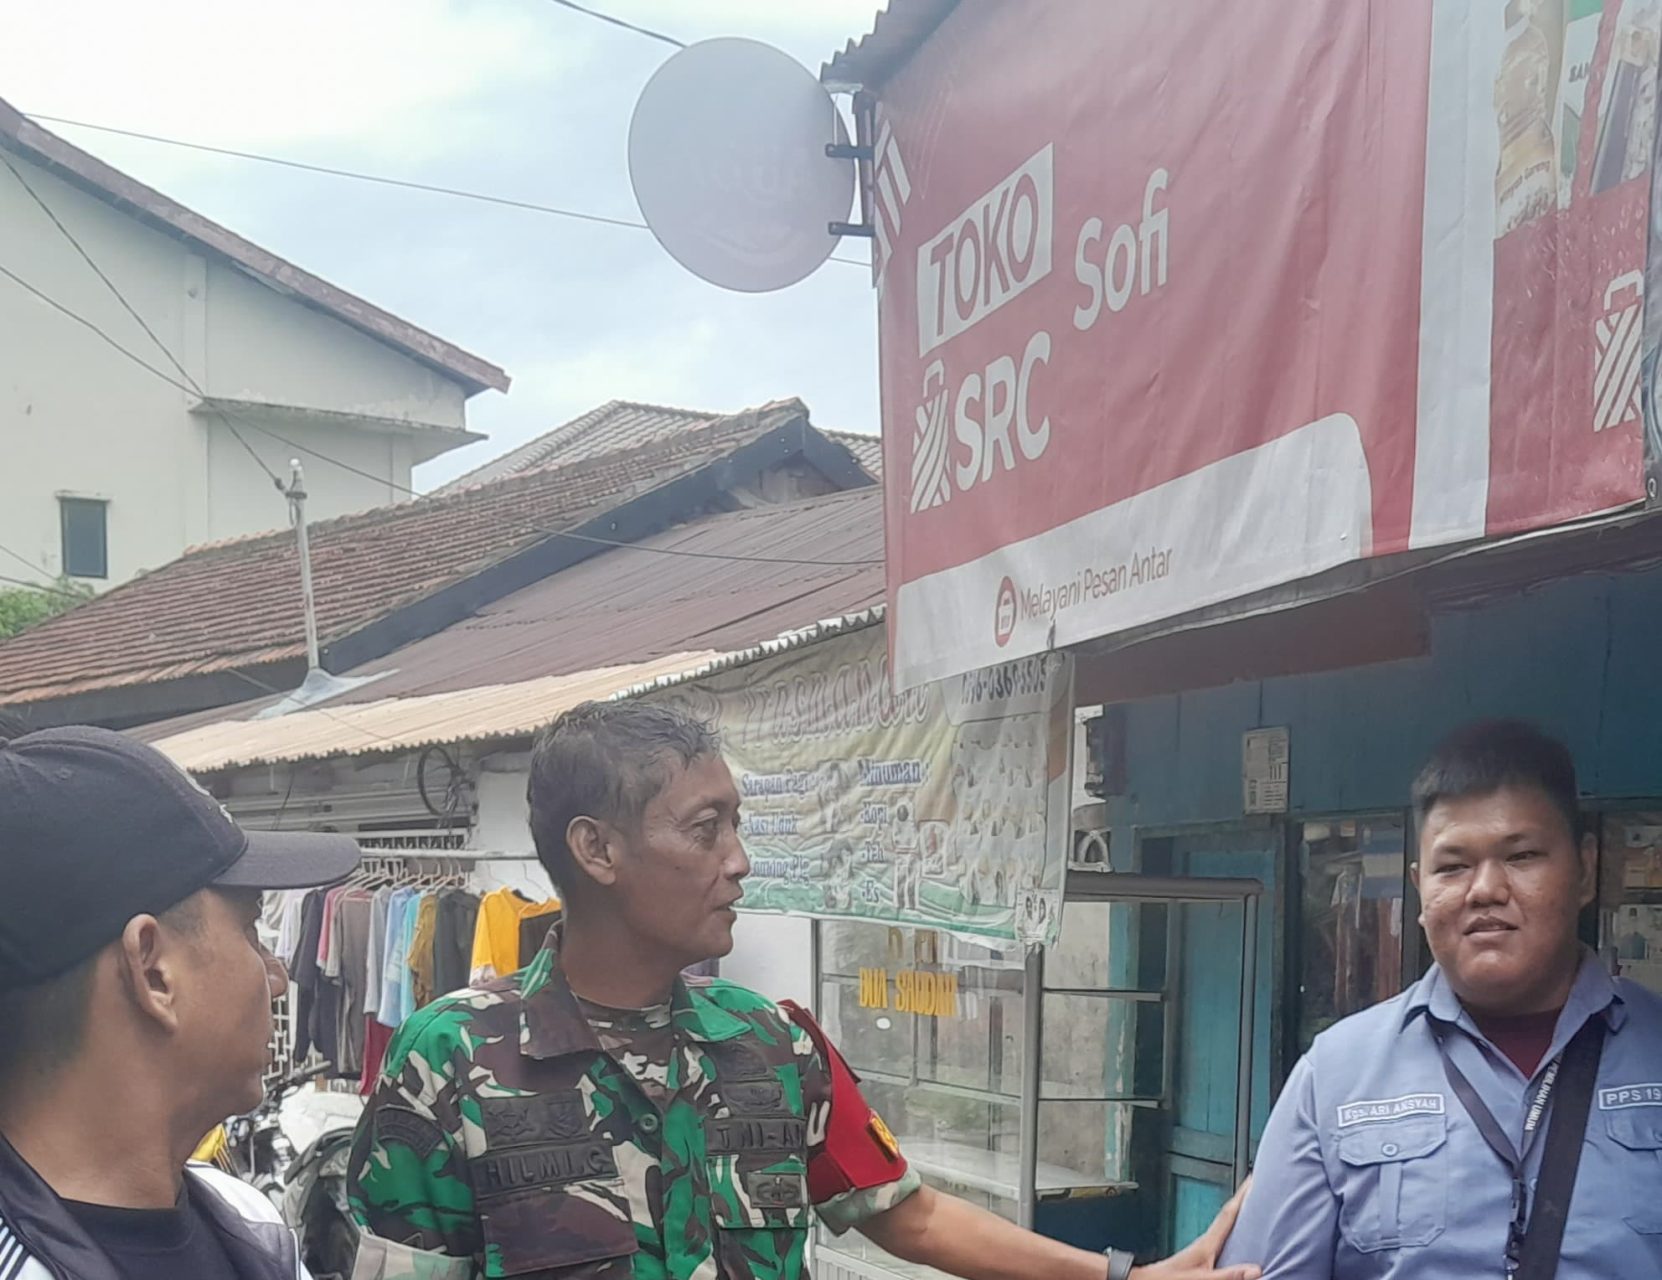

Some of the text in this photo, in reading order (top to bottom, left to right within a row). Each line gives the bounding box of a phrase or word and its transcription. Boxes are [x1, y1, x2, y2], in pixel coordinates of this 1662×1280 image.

[930, 167, 1169, 337] TOKO Sofi
[955, 331, 1051, 491] SRC
[1020, 546, 1172, 620] Melayani Pesan Antar
[857, 760, 922, 786] Minuman
[859, 966, 888, 1009] DUA
[1606, 1089, 1641, 1105] PPS
